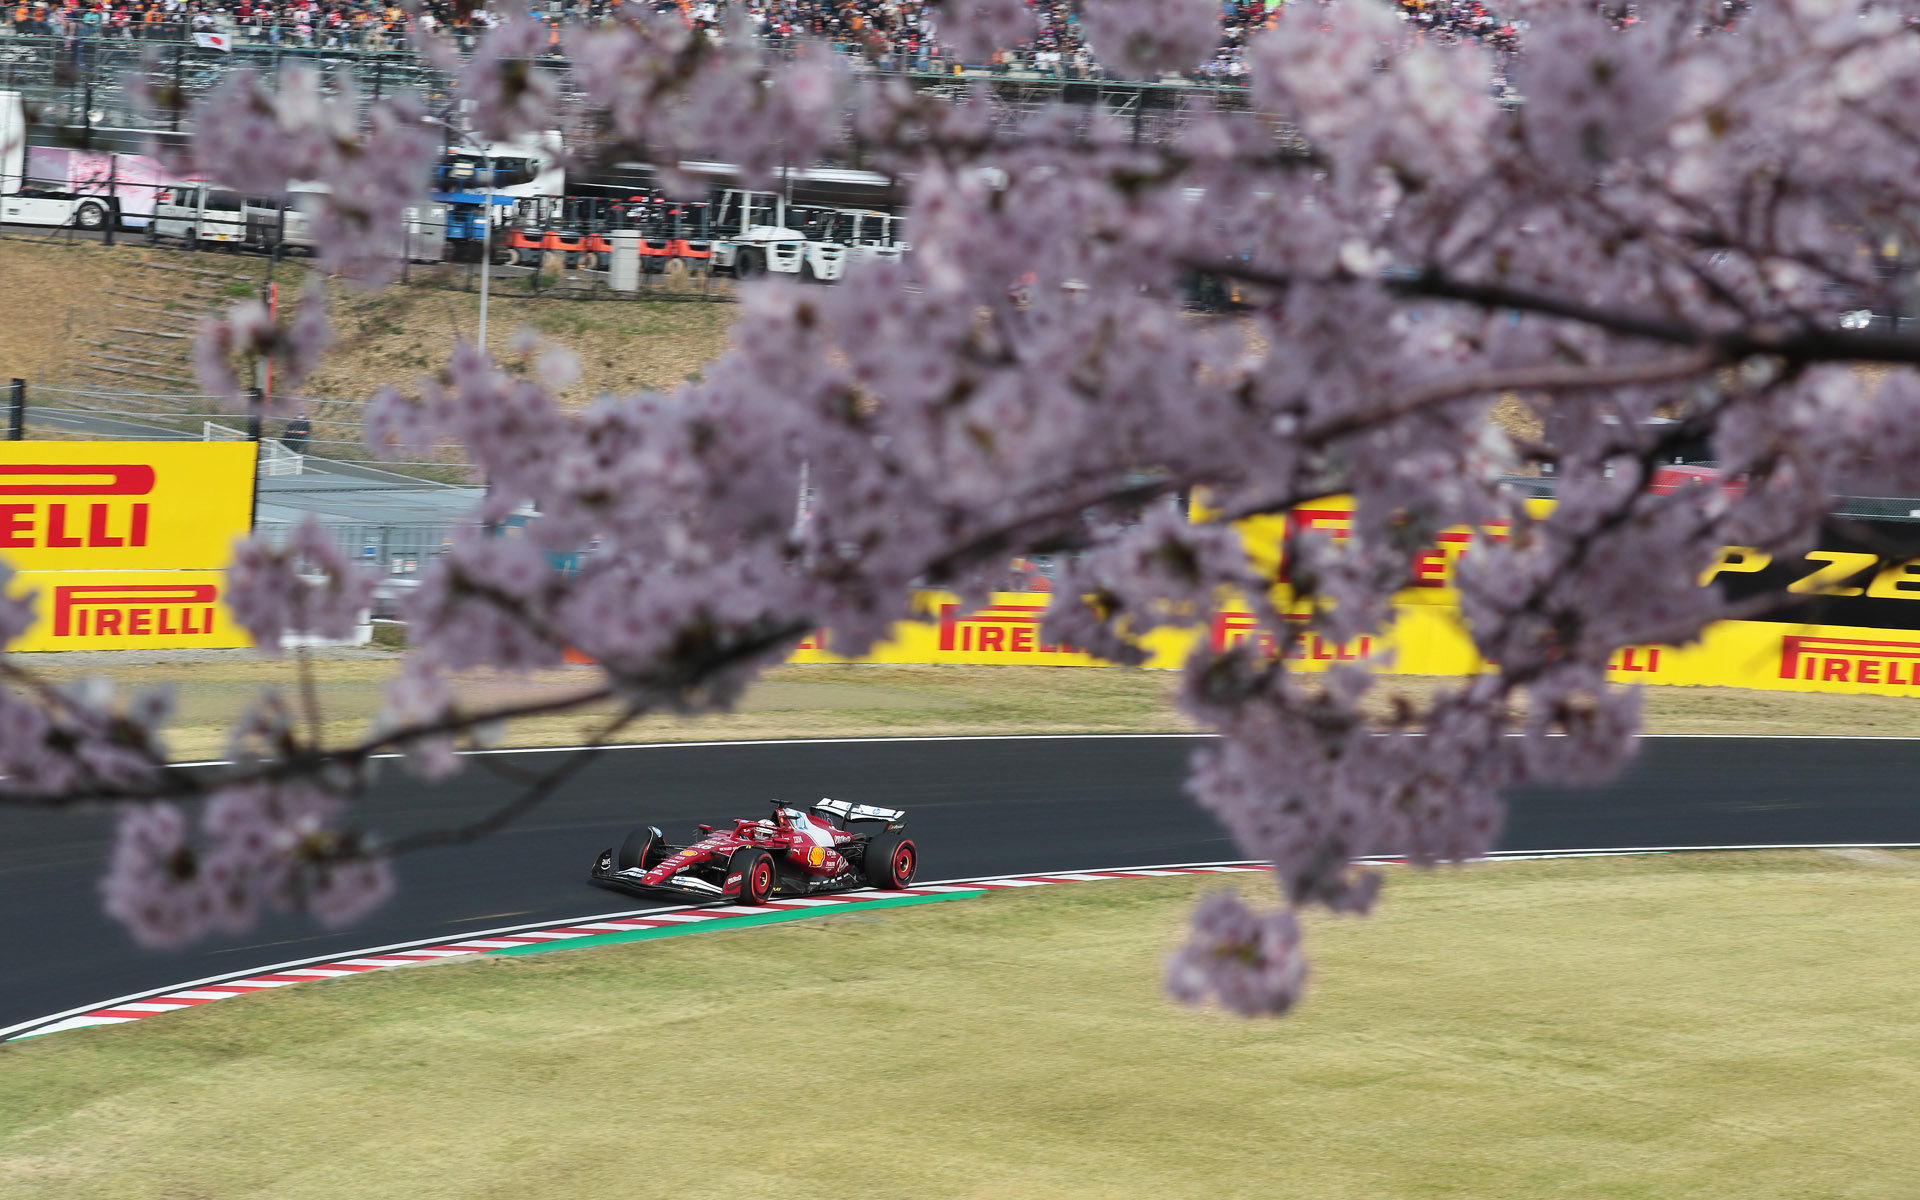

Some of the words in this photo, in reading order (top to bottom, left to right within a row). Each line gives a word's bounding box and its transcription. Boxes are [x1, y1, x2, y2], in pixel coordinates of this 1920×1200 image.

[1787, 551, 1920, 600] ZE
[53, 584, 218, 637] PIRELLI
[939, 604, 1092, 653] PIRE
[1779, 635, 1920, 687] PIREL
